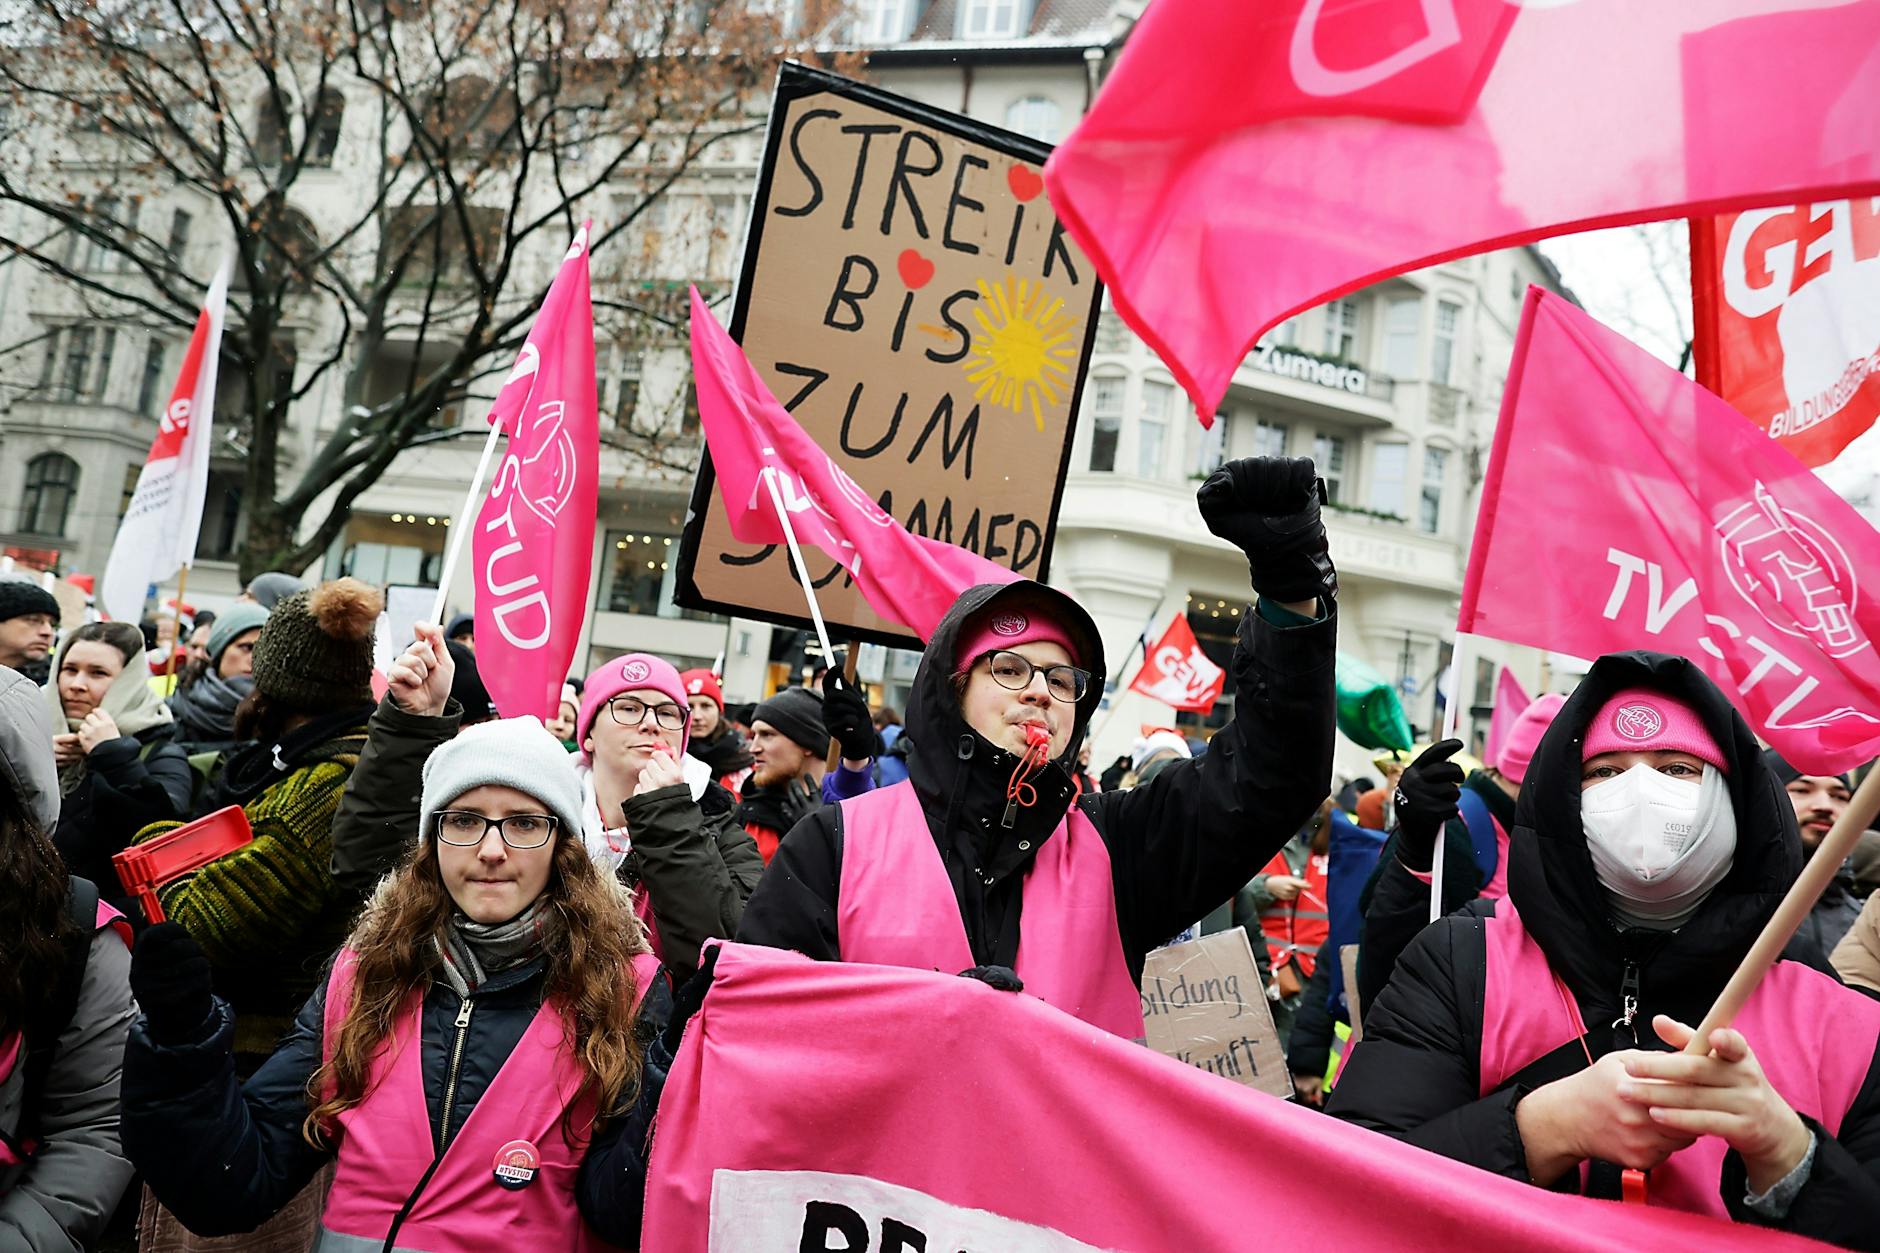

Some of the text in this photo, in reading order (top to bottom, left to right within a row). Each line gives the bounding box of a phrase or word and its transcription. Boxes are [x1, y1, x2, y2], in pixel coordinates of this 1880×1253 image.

[485, 454, 551, 650] STUD
[1602, 547, 1699, 635] TV
[499, 1165, 531, 1179] #TVSTUD
